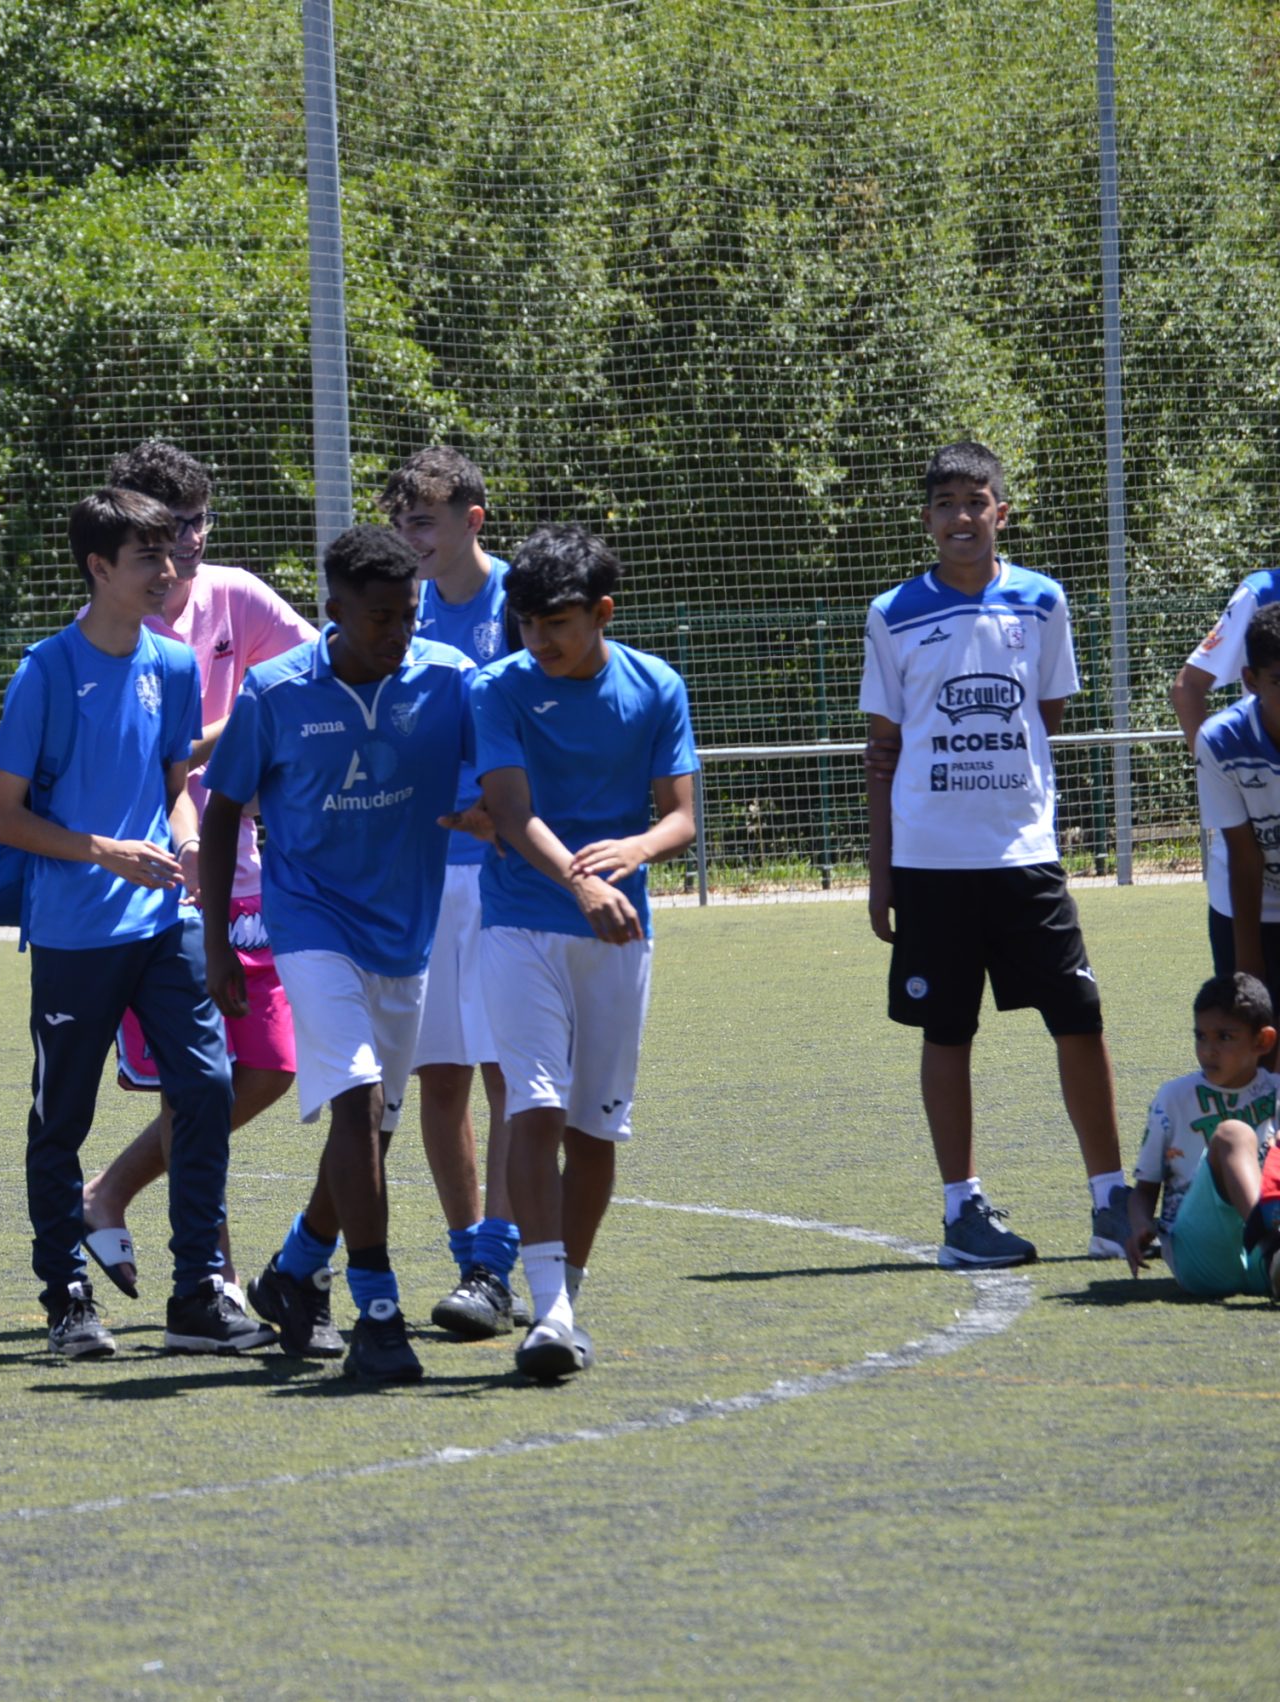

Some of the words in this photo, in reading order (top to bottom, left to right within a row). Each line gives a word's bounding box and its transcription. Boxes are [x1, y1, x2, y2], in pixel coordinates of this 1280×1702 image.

[945, 683, 1015, 706] Ezequiel
[950, 732, 1027, 753] COESA
[951, 761, 994, 772] PATATAS
[951, 773, 1028, 791] HIJOLUSA
[322, 786, 414, 811] Almudena
